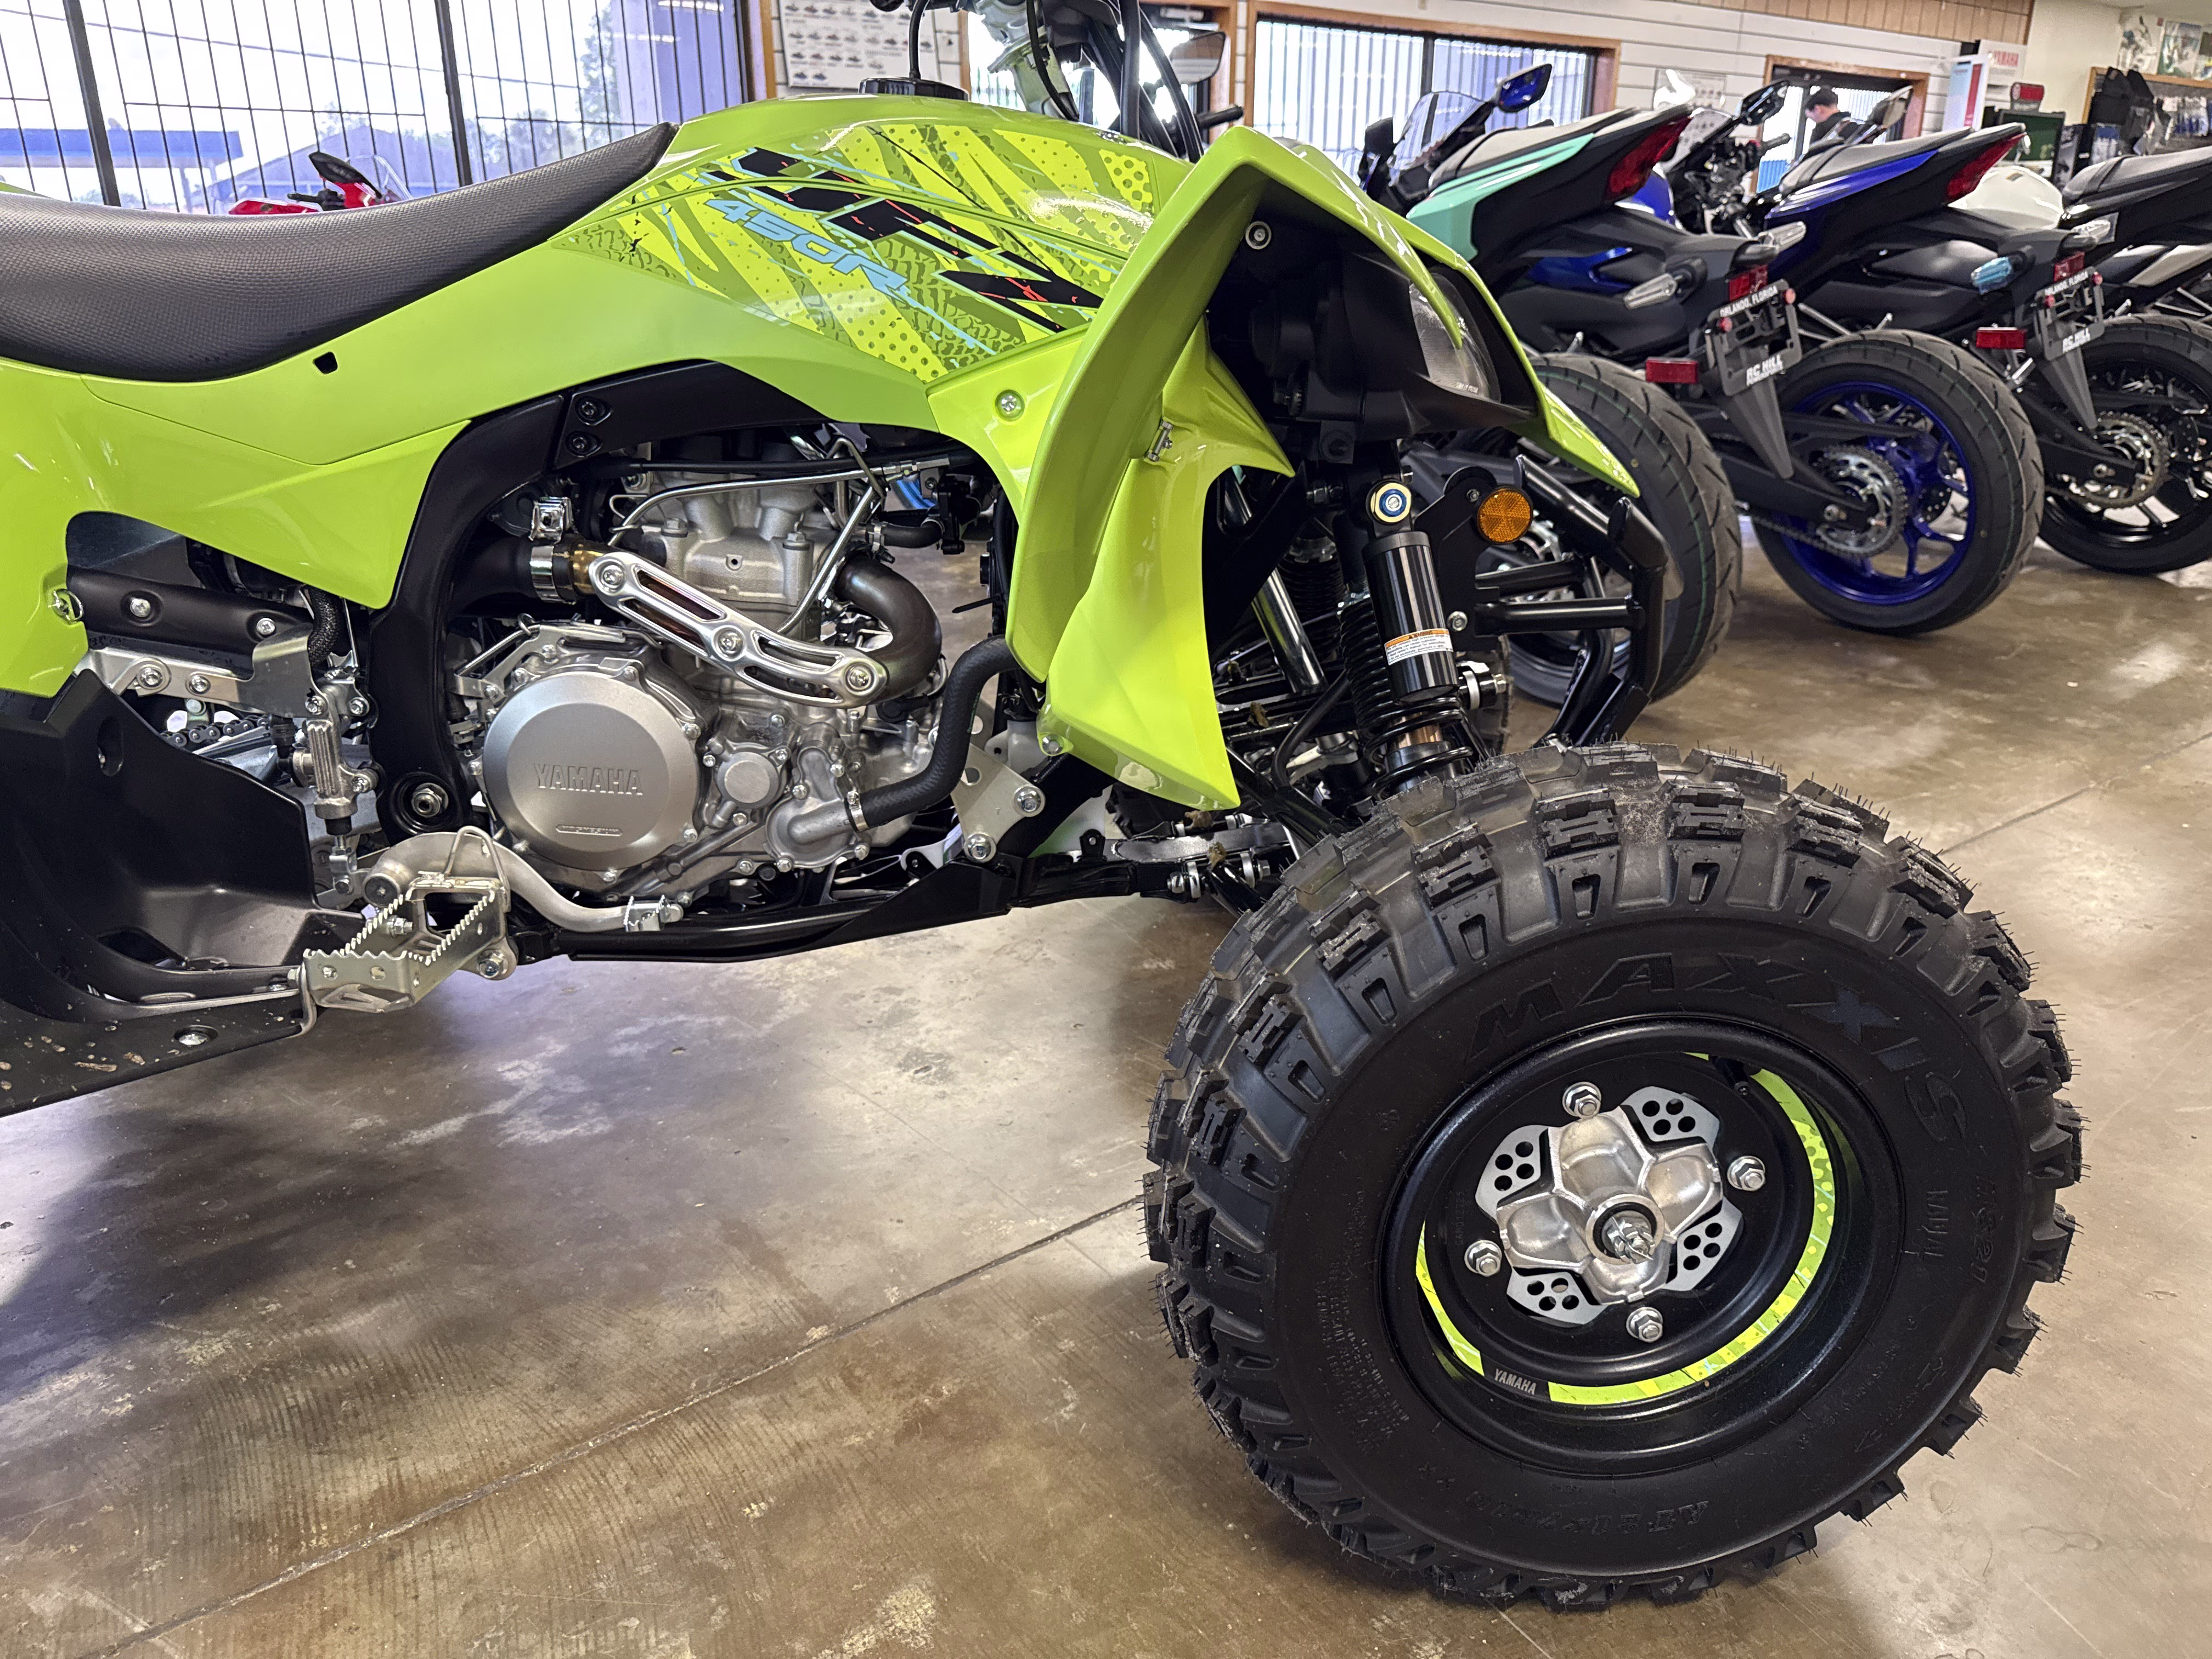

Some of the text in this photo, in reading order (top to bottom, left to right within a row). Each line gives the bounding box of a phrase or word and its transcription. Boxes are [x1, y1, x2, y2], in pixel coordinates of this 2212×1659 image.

[704, 199, 909, 300] 450R
[1751, 285, 1779, 304] FLORIDA
[1761, 354, 1783, 374] HILL
[533, 763, 644, 795] YAMAHA
[1465, 951, 1968, 1143] MAXXIS
[1494, 1368, 1537, 1395] YAMAHA
